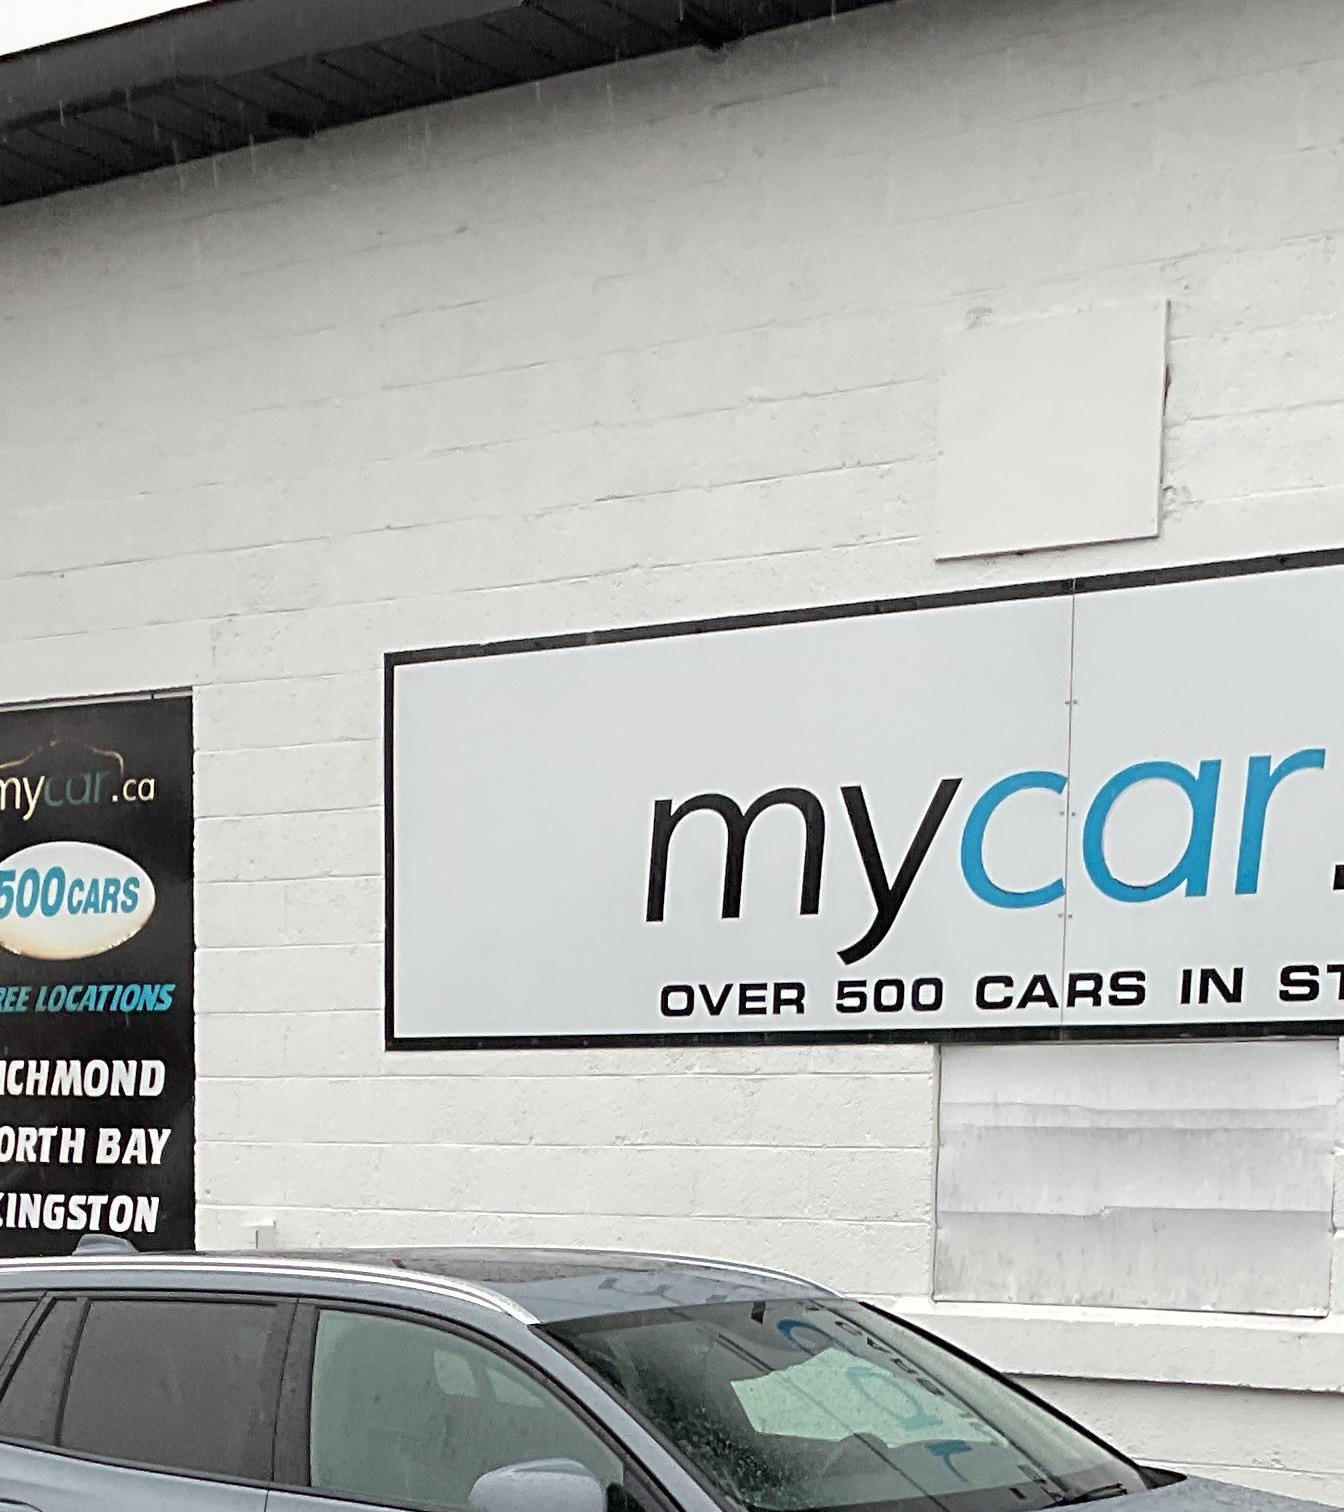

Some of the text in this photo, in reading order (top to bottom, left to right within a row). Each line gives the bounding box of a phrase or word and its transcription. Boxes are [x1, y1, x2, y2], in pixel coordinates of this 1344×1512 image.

[35, 983, 176, 1013] LOCATIONS
[660, 982, 806, 1017] OVER
[836, 976, 944, 1014] 500
[975, 970, 1146, 1010] CARS
[1180, 967, 1244, 1005] IN
[95, 1127, 172, 1165] BAY
